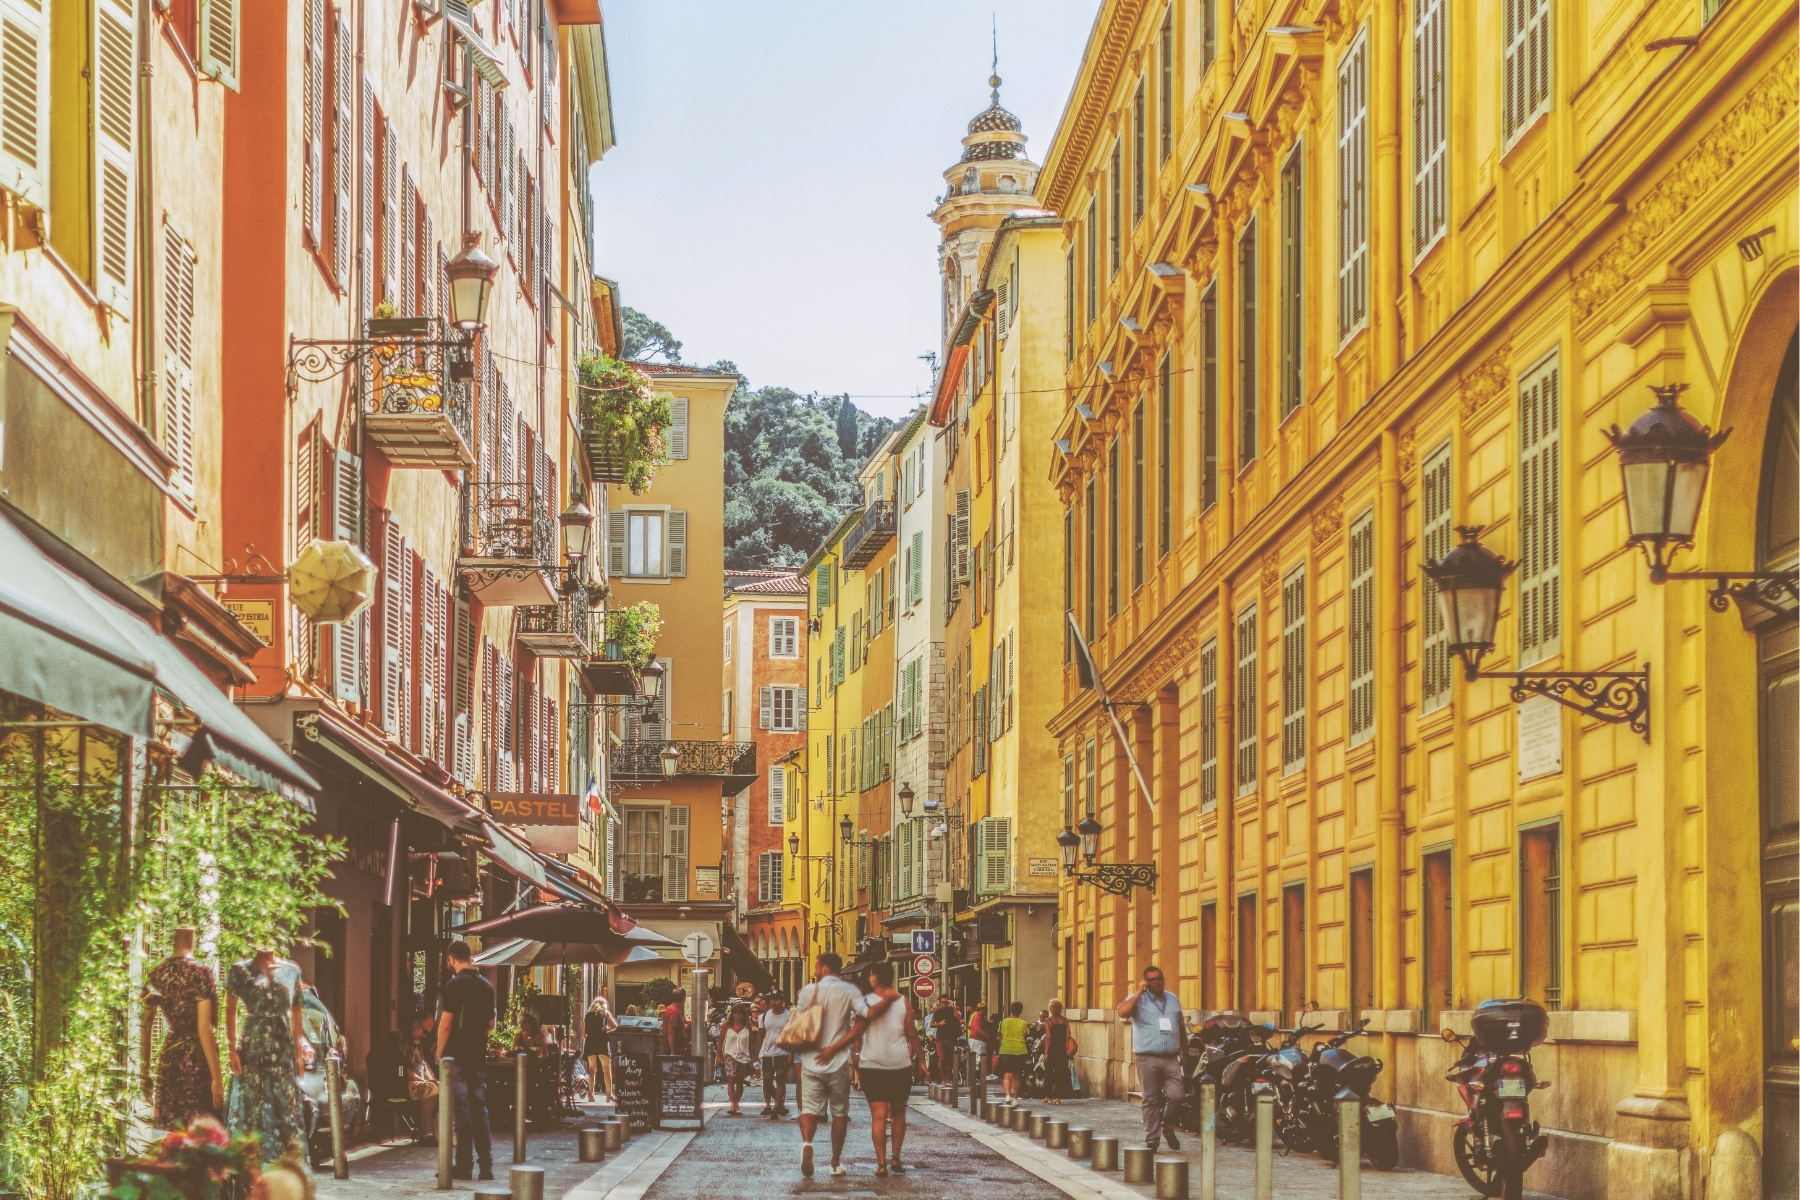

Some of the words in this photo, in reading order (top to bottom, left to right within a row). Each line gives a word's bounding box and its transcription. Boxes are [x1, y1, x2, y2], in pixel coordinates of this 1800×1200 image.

[228, 603, 243, 611] RUE
[239, 613, 269, 621] D'ISTRIA
[490, 799, 576, 818] PASTEL
[615, 1054, 637, 1067] Take
